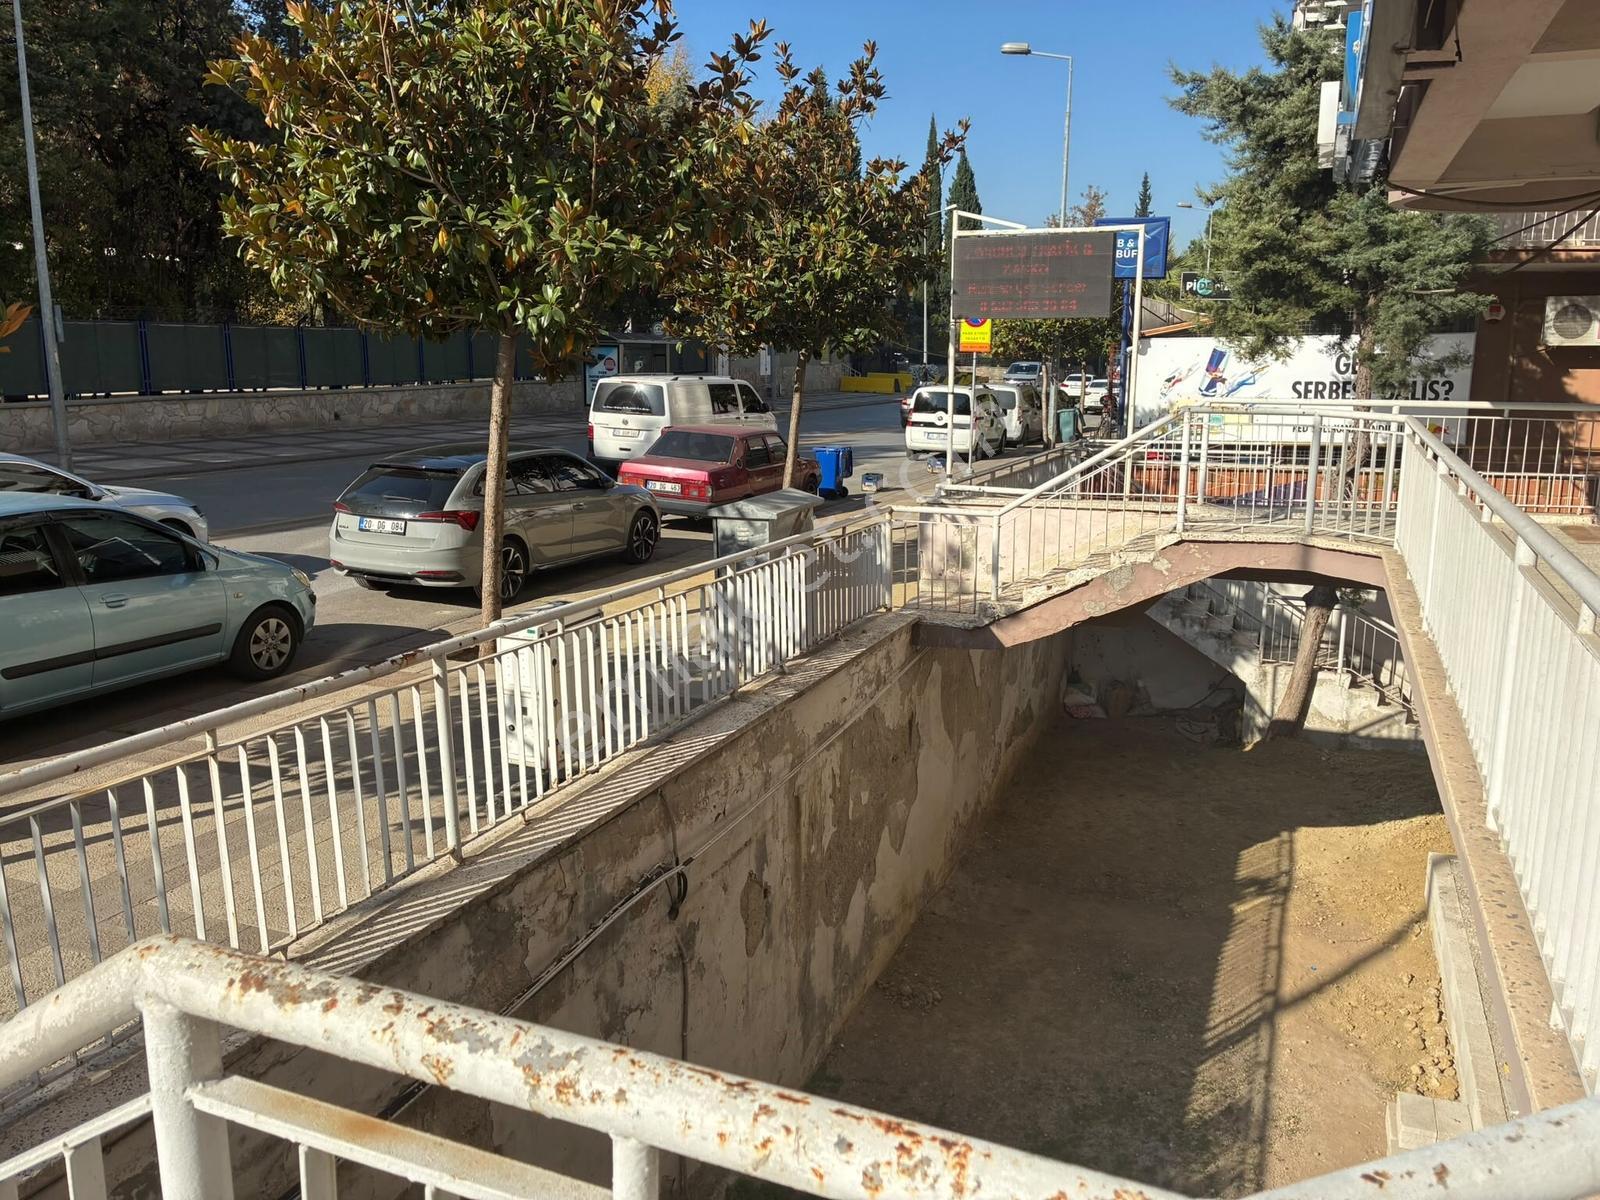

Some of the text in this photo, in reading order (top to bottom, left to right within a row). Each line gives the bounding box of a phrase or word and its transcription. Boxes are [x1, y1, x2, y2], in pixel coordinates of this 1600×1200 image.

[1116, 238, 1135, 248] B &
[1115, 247, 1138, 259] BÜF
